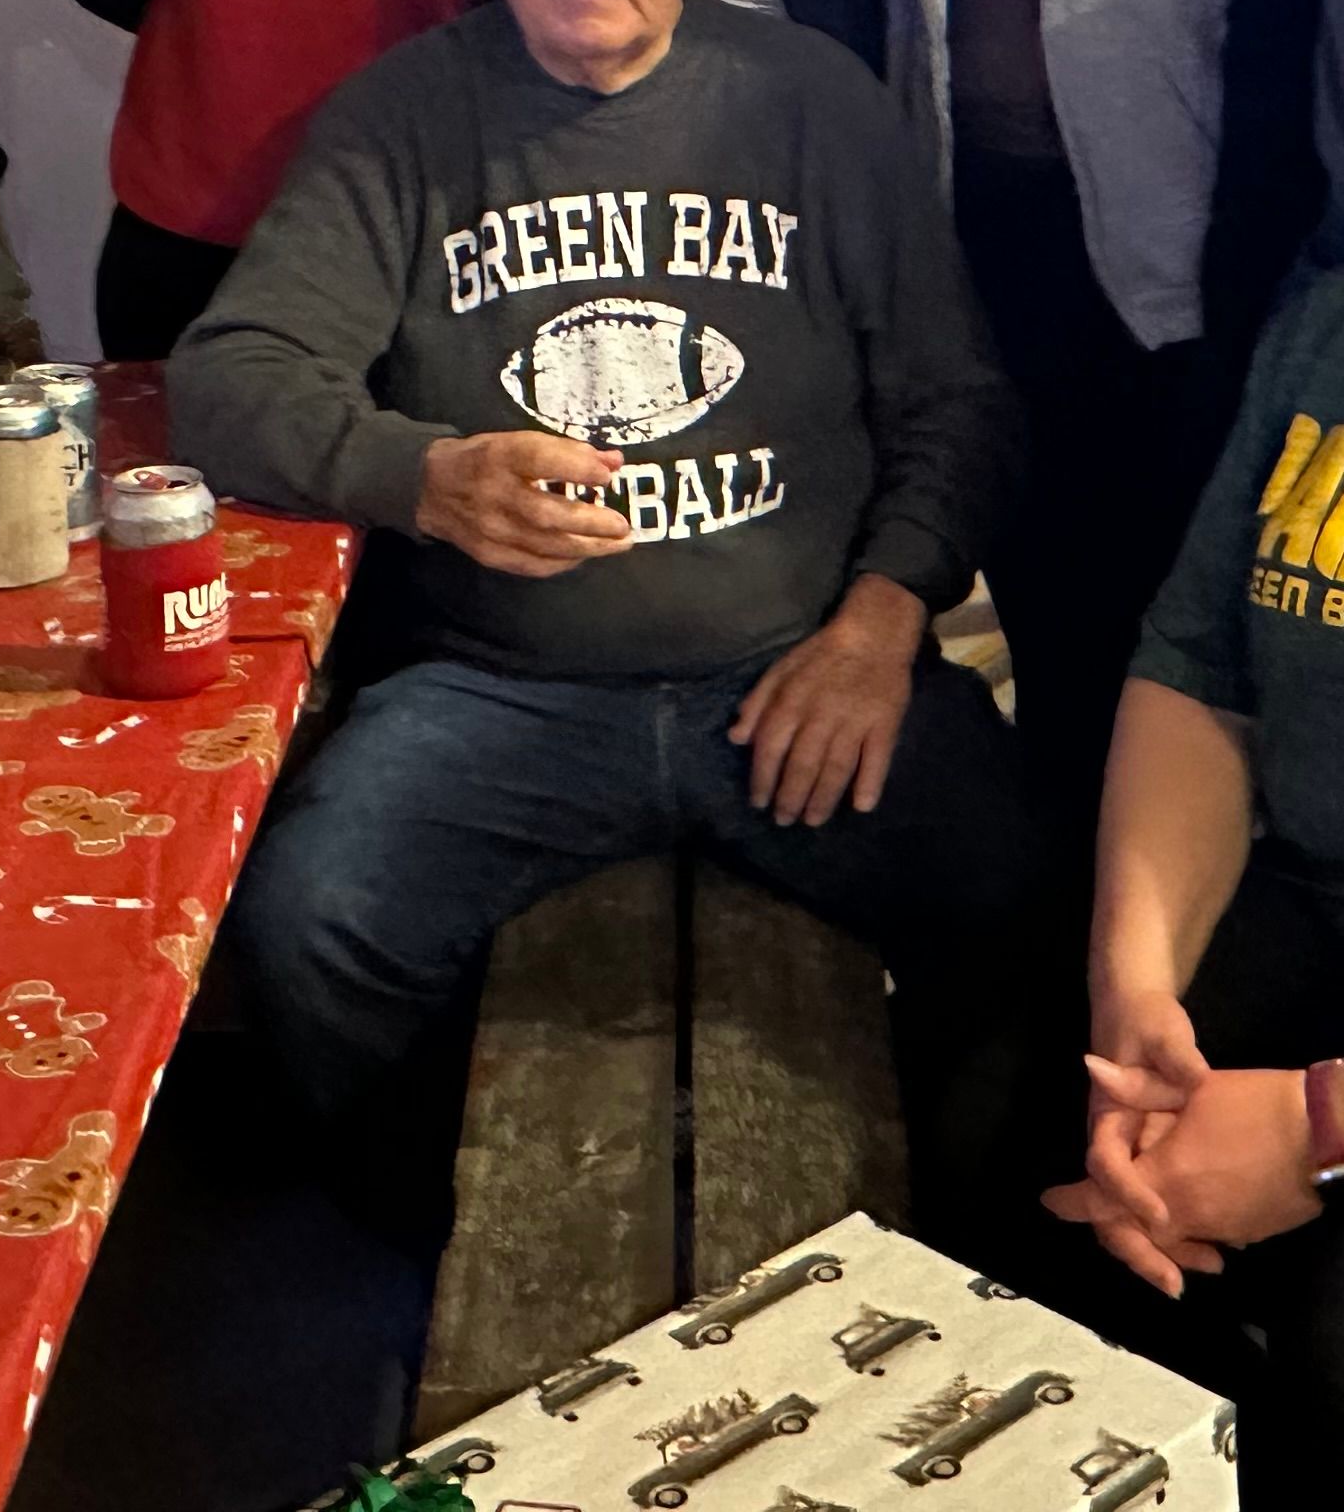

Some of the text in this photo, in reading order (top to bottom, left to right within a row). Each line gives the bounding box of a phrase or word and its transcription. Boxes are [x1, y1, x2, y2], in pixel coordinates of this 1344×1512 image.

[442, 190, 799, 314] GREEN BAY
[538, 446, 786, 544] BALL
